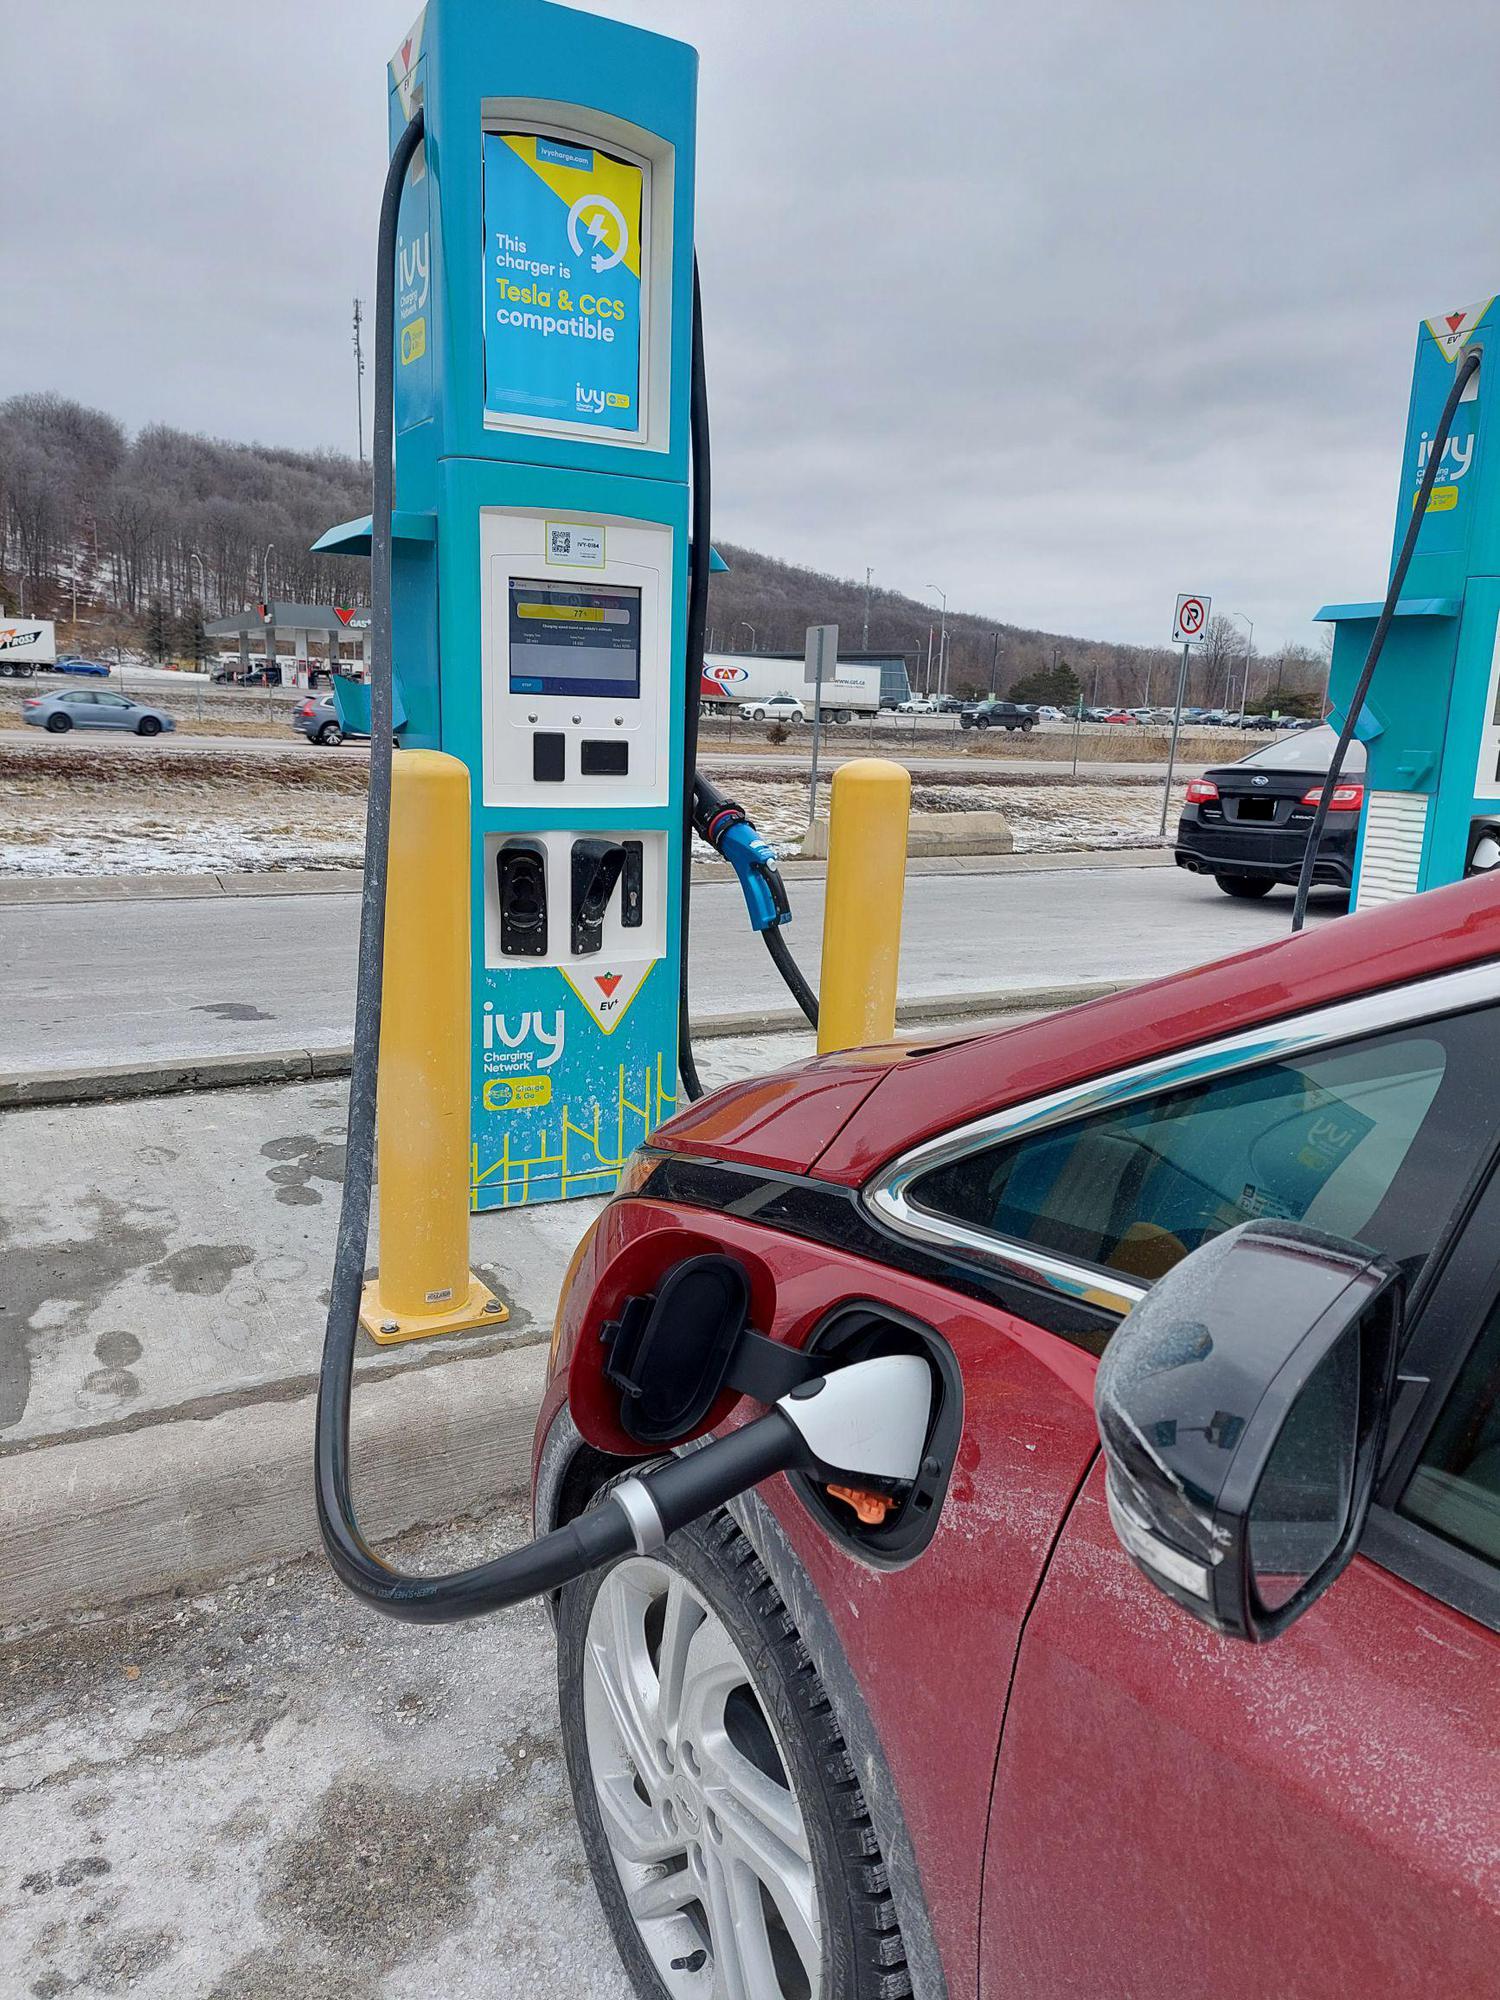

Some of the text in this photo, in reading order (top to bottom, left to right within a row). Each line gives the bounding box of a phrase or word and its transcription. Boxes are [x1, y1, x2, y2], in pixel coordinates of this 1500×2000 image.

[496, 232, 527, 254] This
[399, 231, 428, 309] ivy
[496, 253, 571, 279] charger is
[495, 277, 625, 321] Tesla & CCS
[496, 308, 615, 343] compatible
[575, 382, 606, 414] ivy
[1415, 475, 1446, 485] Nork
[600, 1001, 614, 1011] EV
[483, 1001, 565, 1069] ivy
[483, 1050, 534, 1063] Charging
[483, 1061, 530, 1073] Network
